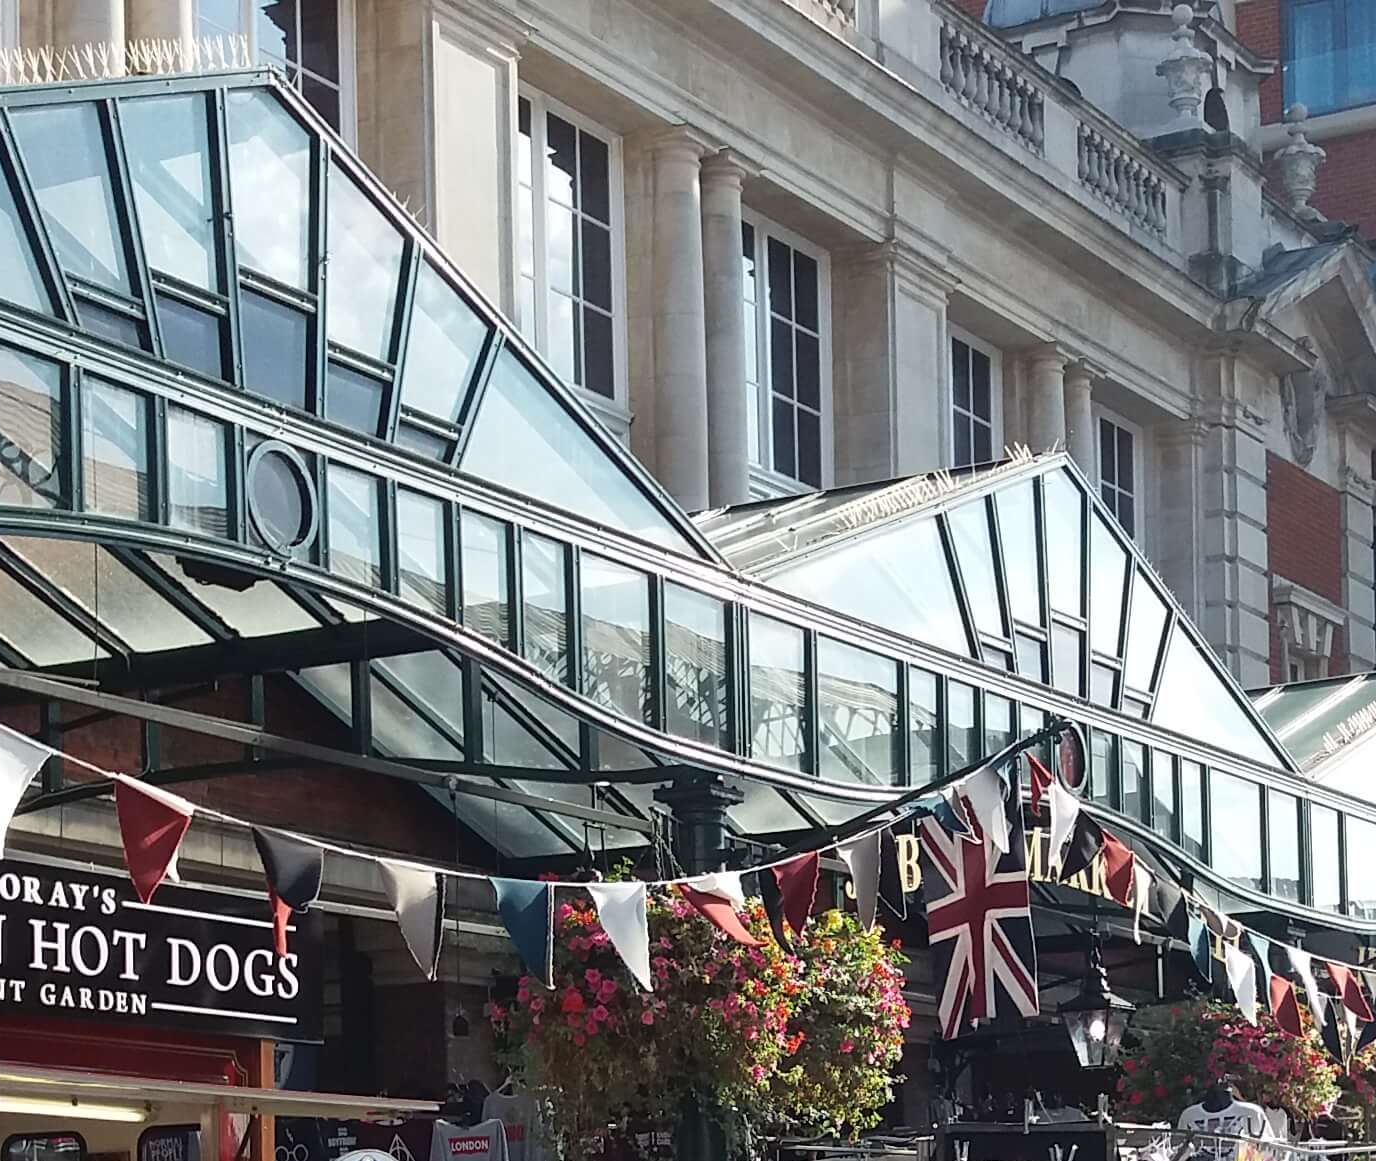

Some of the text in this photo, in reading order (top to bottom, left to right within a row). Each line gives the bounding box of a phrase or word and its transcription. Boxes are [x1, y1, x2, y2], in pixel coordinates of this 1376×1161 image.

[28, 918, 147, 980] HOT
[166, 937, 298, 999] DOGS
[40, 983, 147, 1015] GARDEN
[451, 1139, 489, 1152] LONDON
